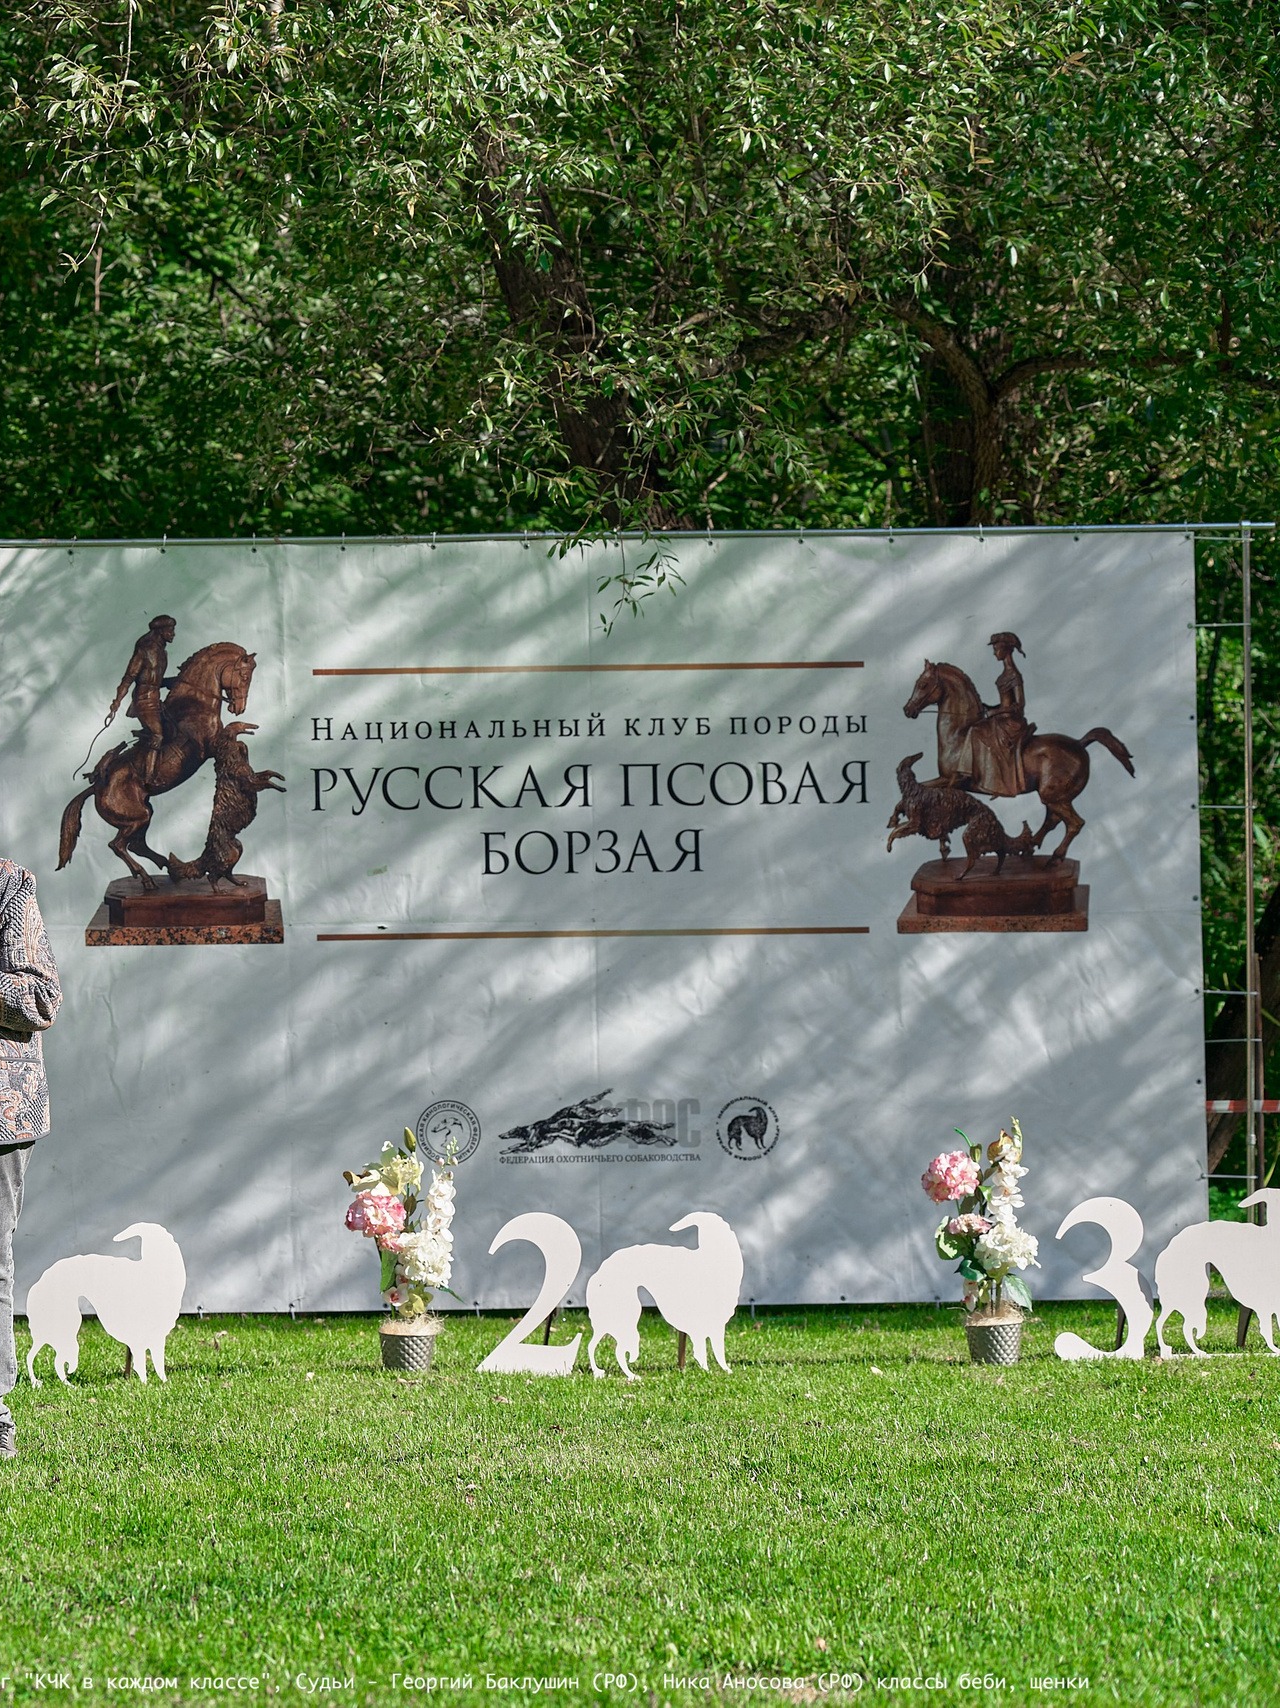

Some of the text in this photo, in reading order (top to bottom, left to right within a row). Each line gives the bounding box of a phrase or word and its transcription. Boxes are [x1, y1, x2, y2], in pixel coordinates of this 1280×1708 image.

[310, 760, 870, 816] РУССКАЯ ПСОВАЯ
[480, 828, 704, 876] БОРЗАЯ
[418, 1123, 445, 1161] ОССИЙСКАЯ
[499, 1153, 701, 1165] ФЕДЕРАЦИЯ ОХОТНИЧЬЕГО СОБАКОВОДСТВА
[477, 1211, 583, 1377] 2
[1054, 1197, 1154, 1361] 3
